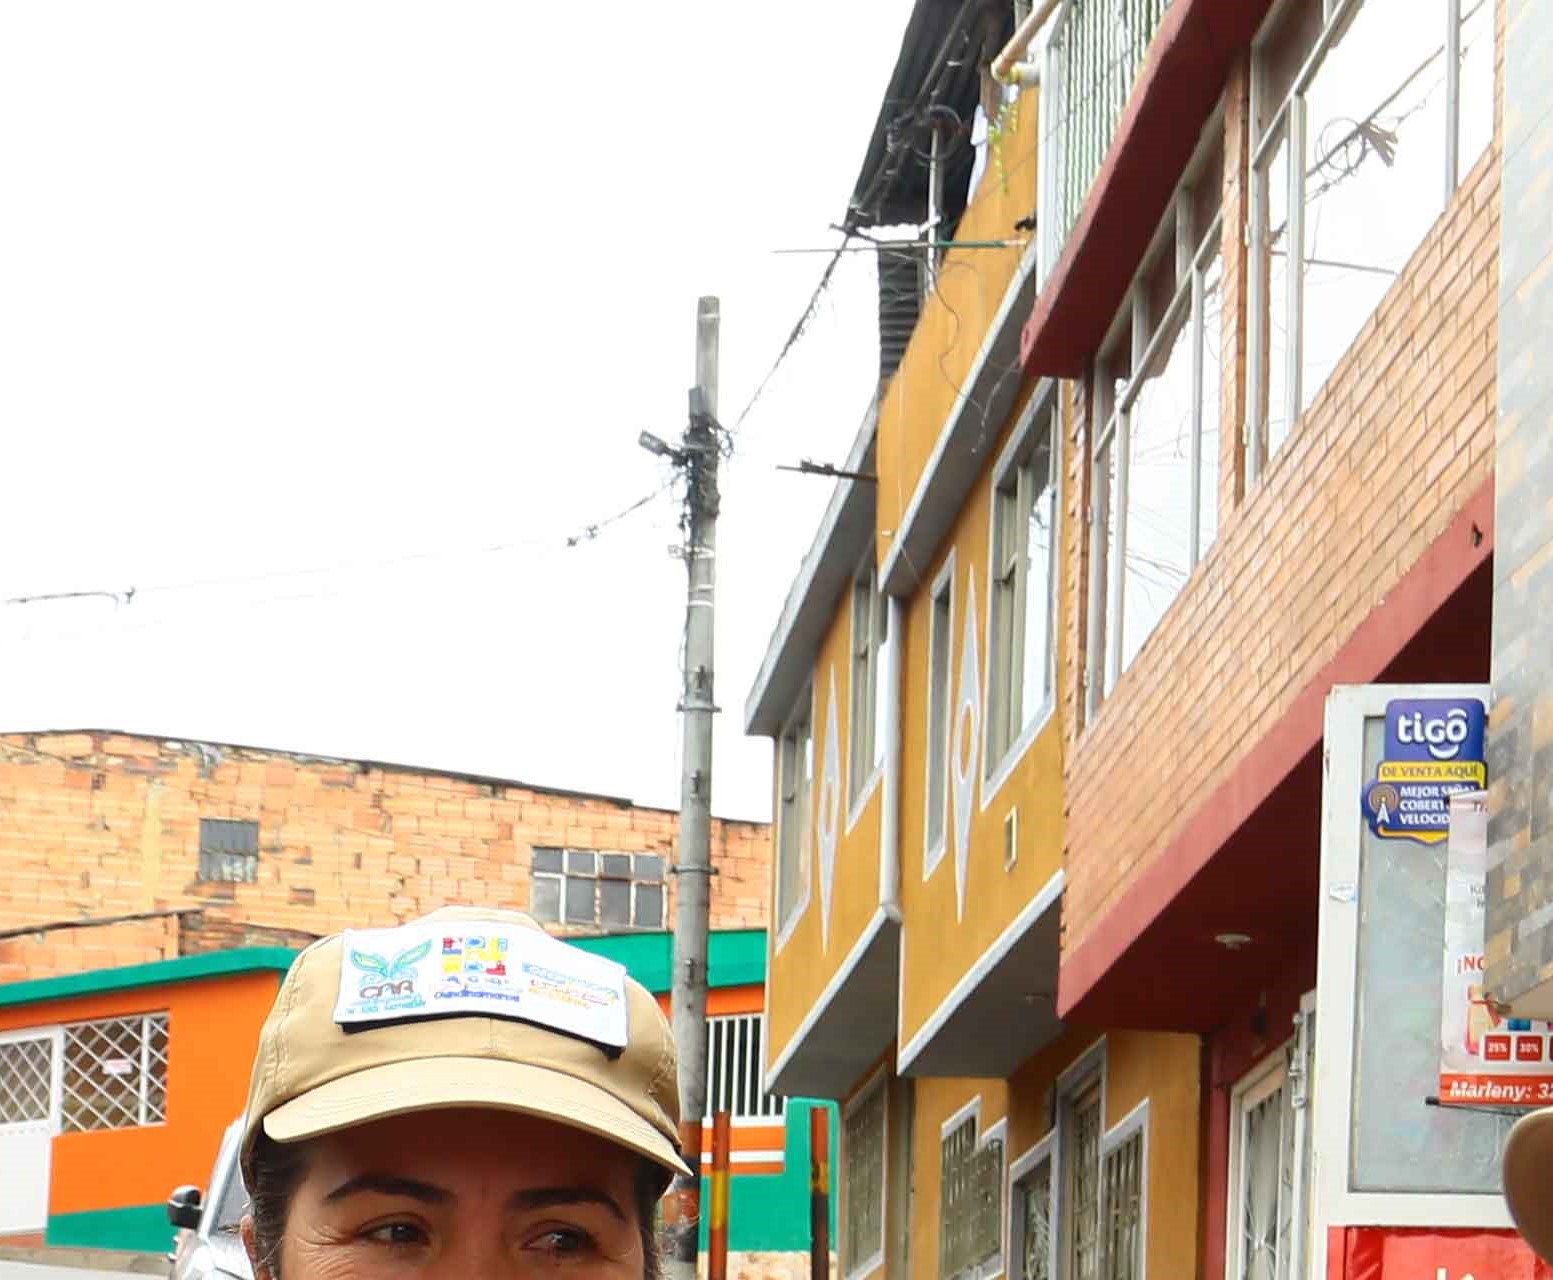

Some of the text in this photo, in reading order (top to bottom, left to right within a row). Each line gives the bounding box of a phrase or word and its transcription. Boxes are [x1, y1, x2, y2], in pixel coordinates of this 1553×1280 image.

[1382, 766, 1398, 778] DE
[1402, 766, 1441, 778] VENTA
[1399, 785, 1439, 798] MEJOR
[1399, 799, 1449, 812] COBERT
[1450, 1080, 1532, 1102] Marleny:
